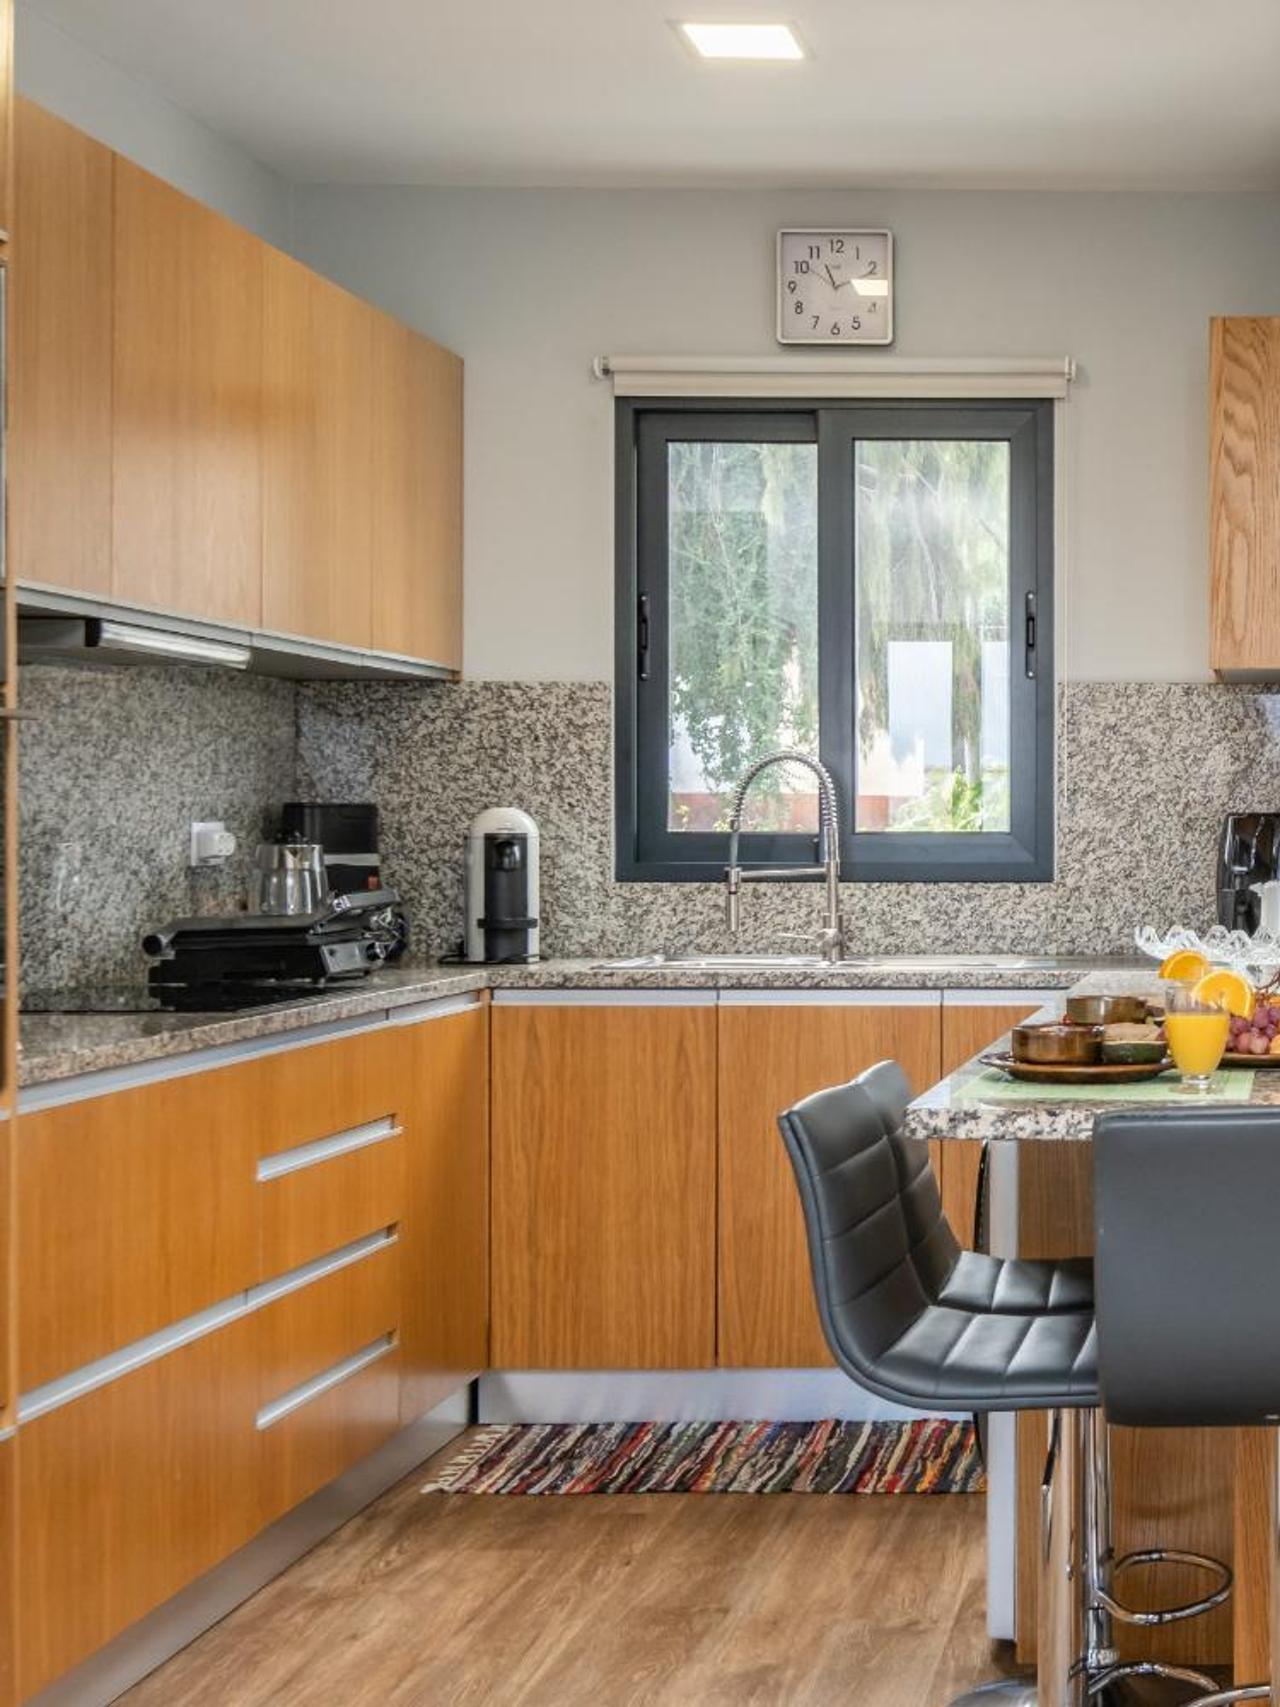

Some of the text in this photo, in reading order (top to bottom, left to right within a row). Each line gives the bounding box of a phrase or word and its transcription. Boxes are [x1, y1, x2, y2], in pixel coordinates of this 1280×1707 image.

[809, 246, 820, 260] 11
[830, 239, 845, 254] 12
[794, 260, 810, 275] 10
[867, 260, 877, 275] 2
[787, 280, 797, 294] 9
[794, 300, 804, 315] 8
[811, 315, 820, 329] 7
[830, 322, 841, 335] 6
[851, 315, 861, 330] 5
